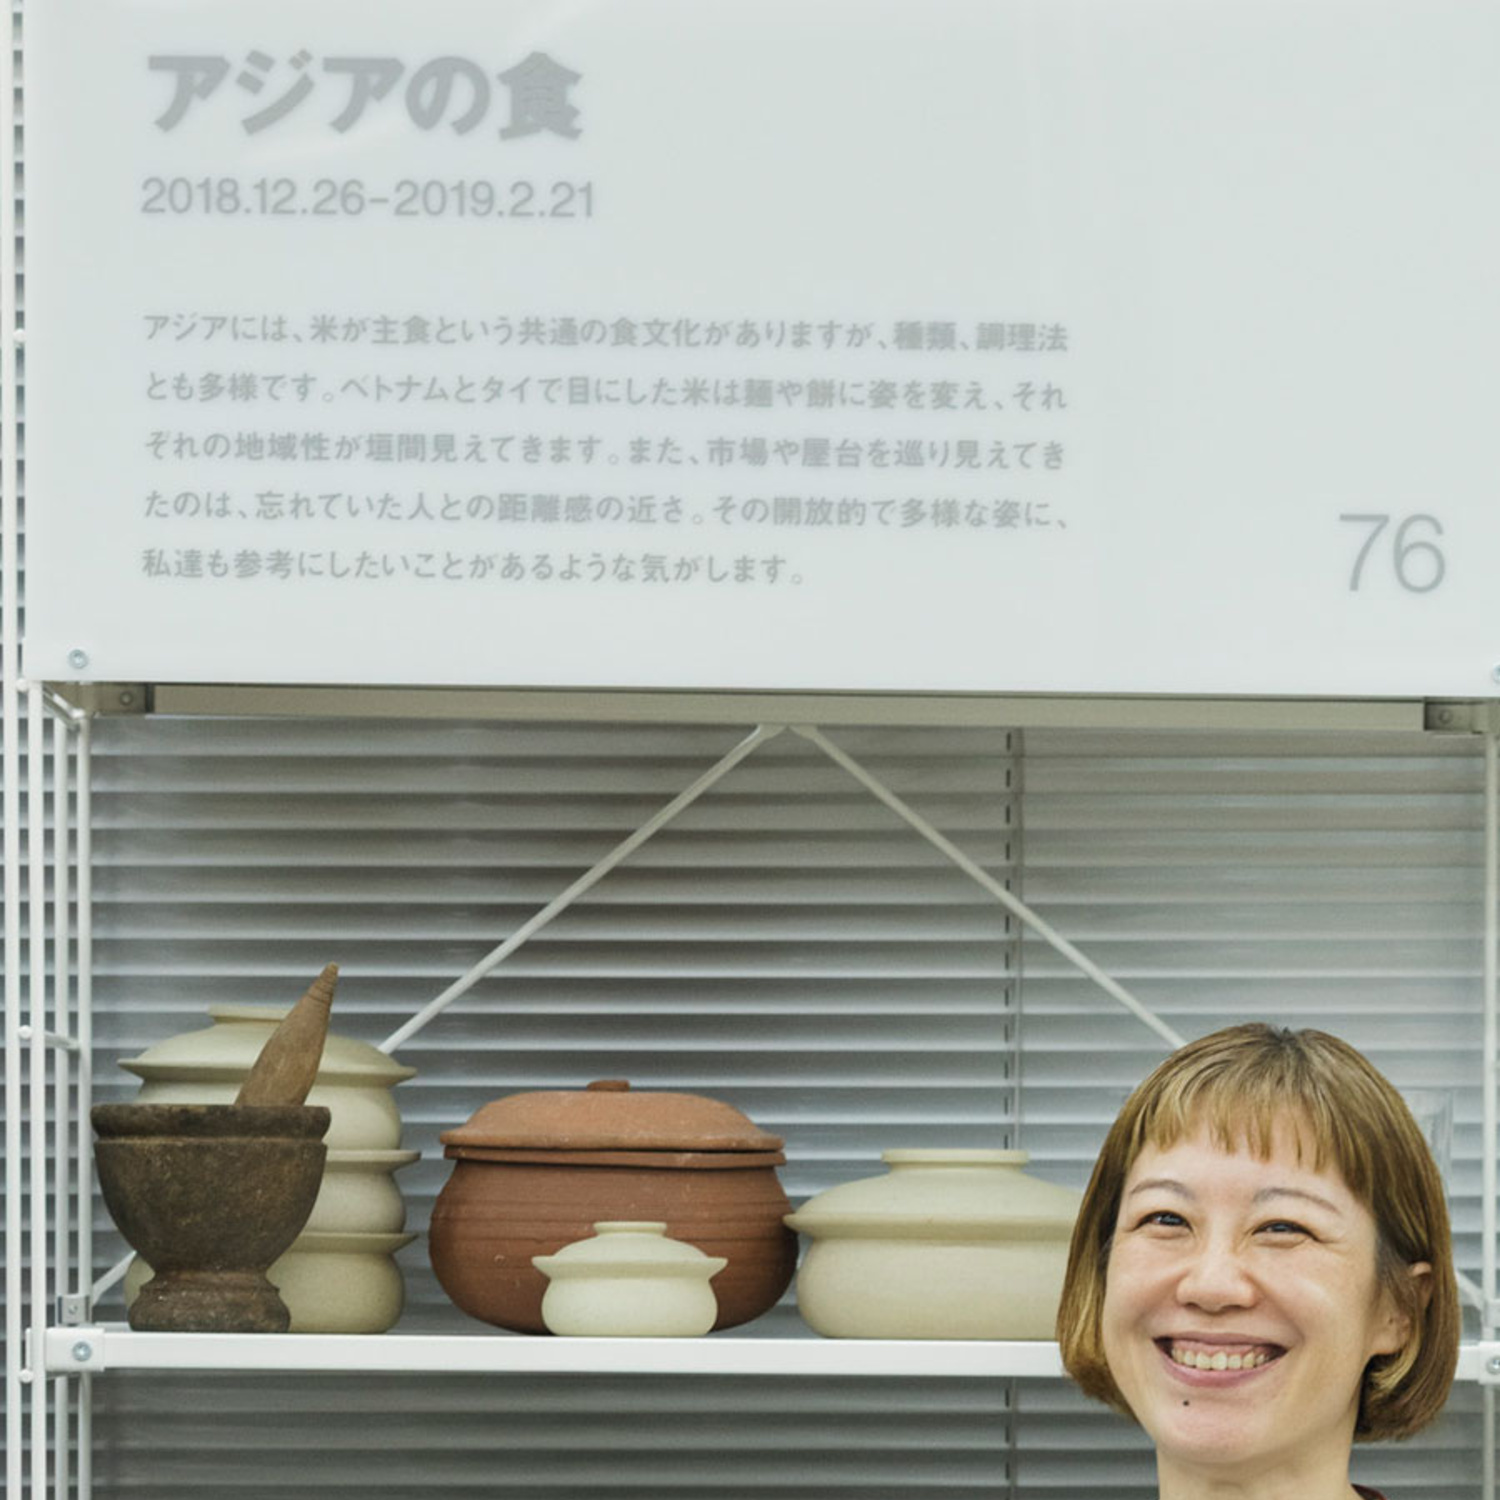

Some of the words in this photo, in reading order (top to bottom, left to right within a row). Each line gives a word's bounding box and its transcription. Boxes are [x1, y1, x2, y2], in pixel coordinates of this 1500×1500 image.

[146, 47, 585, 143] アジアの食
[140, 546, 803, 586] 私達も参考にしたいことがあるような気がします。
[1337, 512, 1447, 596] 76
